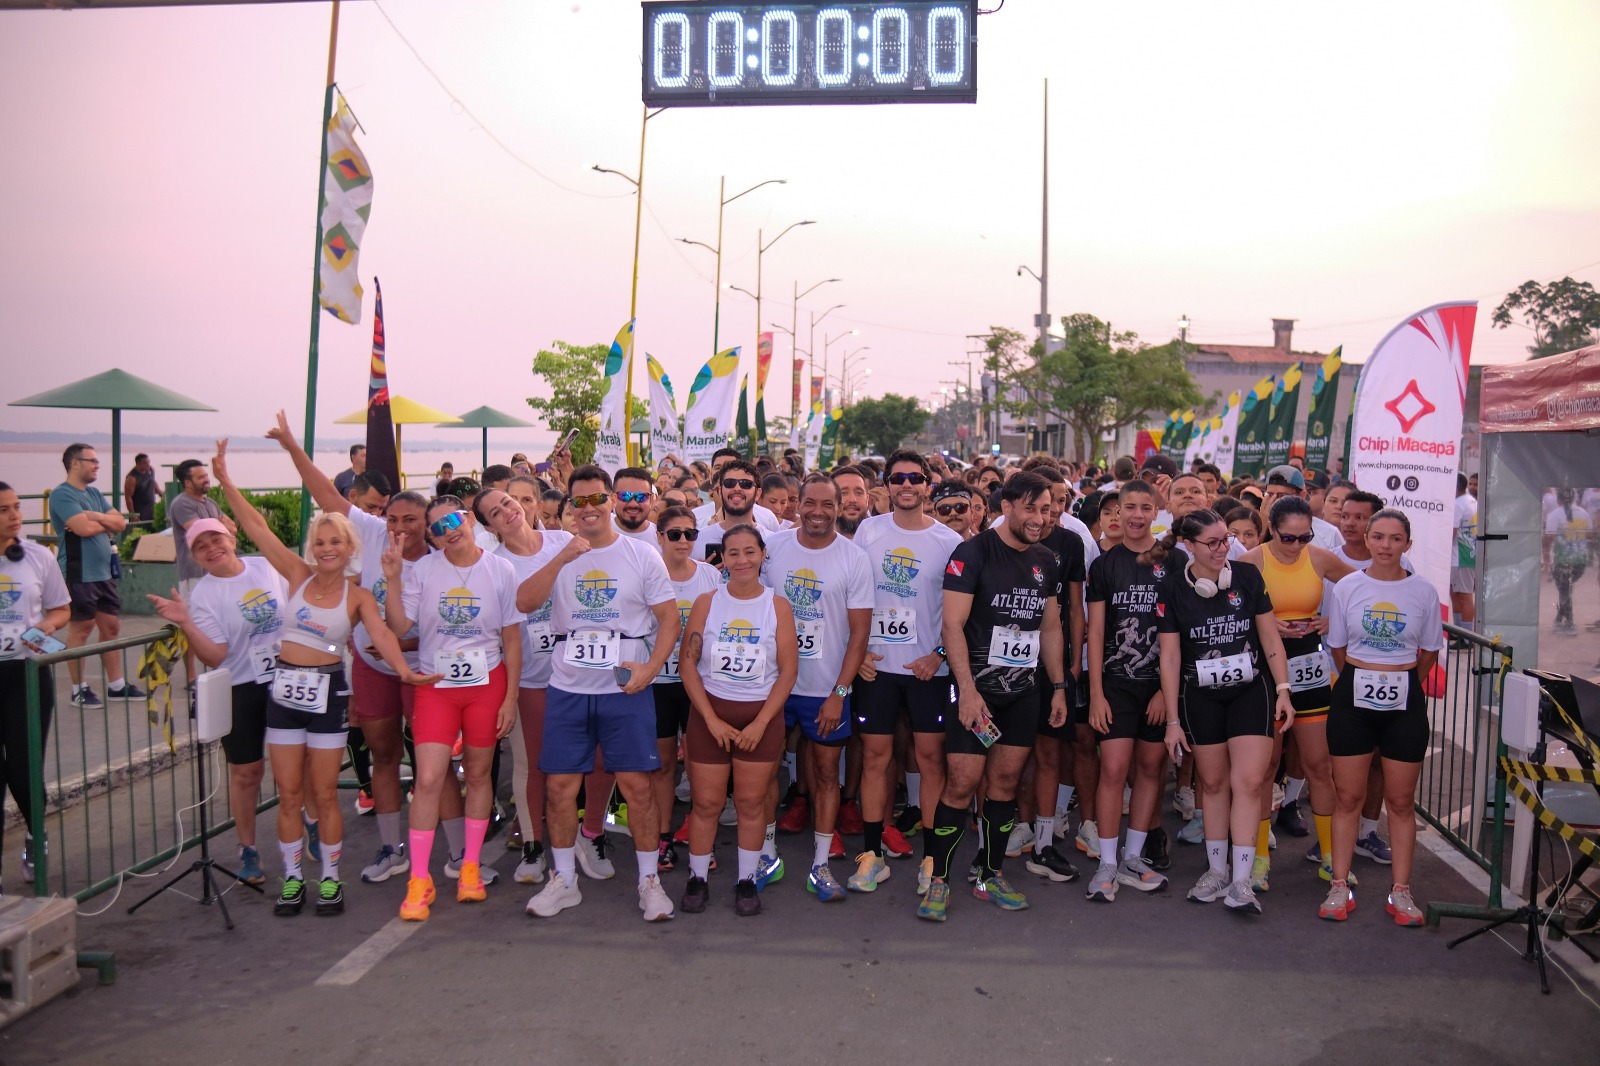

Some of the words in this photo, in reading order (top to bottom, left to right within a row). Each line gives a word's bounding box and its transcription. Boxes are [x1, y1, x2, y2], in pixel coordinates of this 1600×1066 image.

[653, 7, 965, 87] 00:00:00
[686, 432, 727, 446] Marabá
[1359, 436, 1389, 455] Chip
[1397, 437, 1455, 458] Macapá
[1357, 461, 1453, 474] www.chipmacapa.com.br
[1392, 494, 1444, 513] Macapa
[877, 584, 917, 597] PROFESSORES
[1012, 587, 1029, 596] CLUBE
[990, 593, 1047, 610] ATLETISM
[1206, 616, 1226, 625] CLUBE
[1227, 614, 1236, 622] DE
[878, 621, 909, 635] 166
[1190, 618, 1250, 639] ATLETISMO
[574, 644, 608, 660] 311
[1002, 642, 1031, 657] 164
[262, 657, 277, 671] 2
[450, 663, 473, 678] 32
[721, 656, 757, 673] 257
[1210, 668, 1244, 684] 163
[1295, 664, 1323, 683] 356
[282, 684, 318, 702] 355
[1364, 684, 1399, 701] 265
